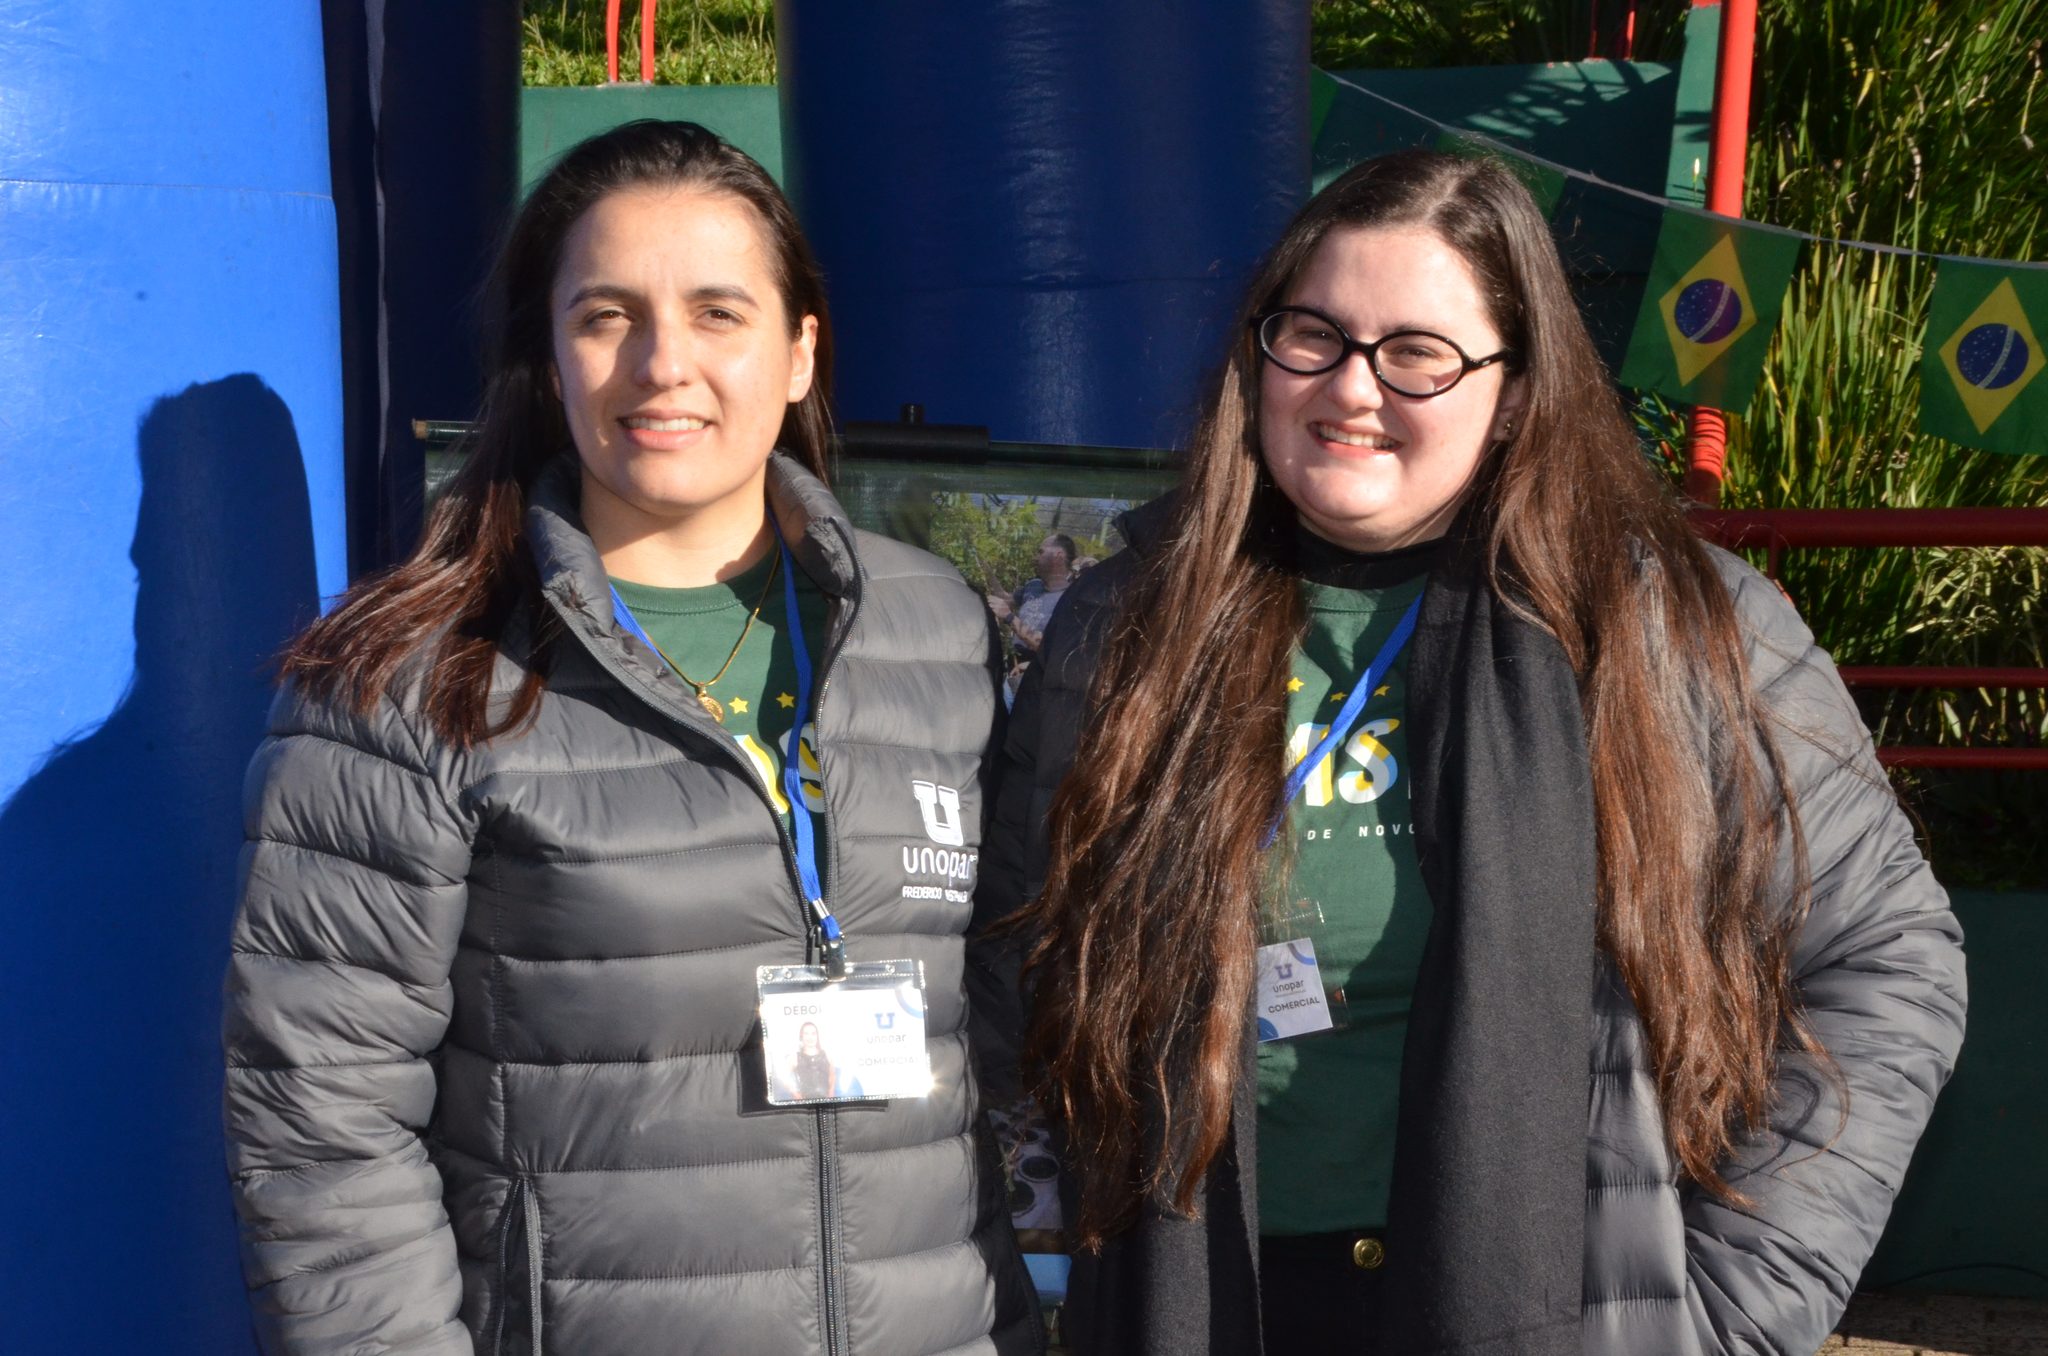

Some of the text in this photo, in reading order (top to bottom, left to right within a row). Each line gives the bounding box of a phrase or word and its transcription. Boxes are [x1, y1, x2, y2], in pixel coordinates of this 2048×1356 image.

[1306, 828, 1332, 841] DE
[902, 846, 977, 887] unopar
[1272, 979, 1304, 994] unopar
[783, 1004, 823, 1017] DEBO
[1267, 996, 1321, 1014] COMERCIAL
